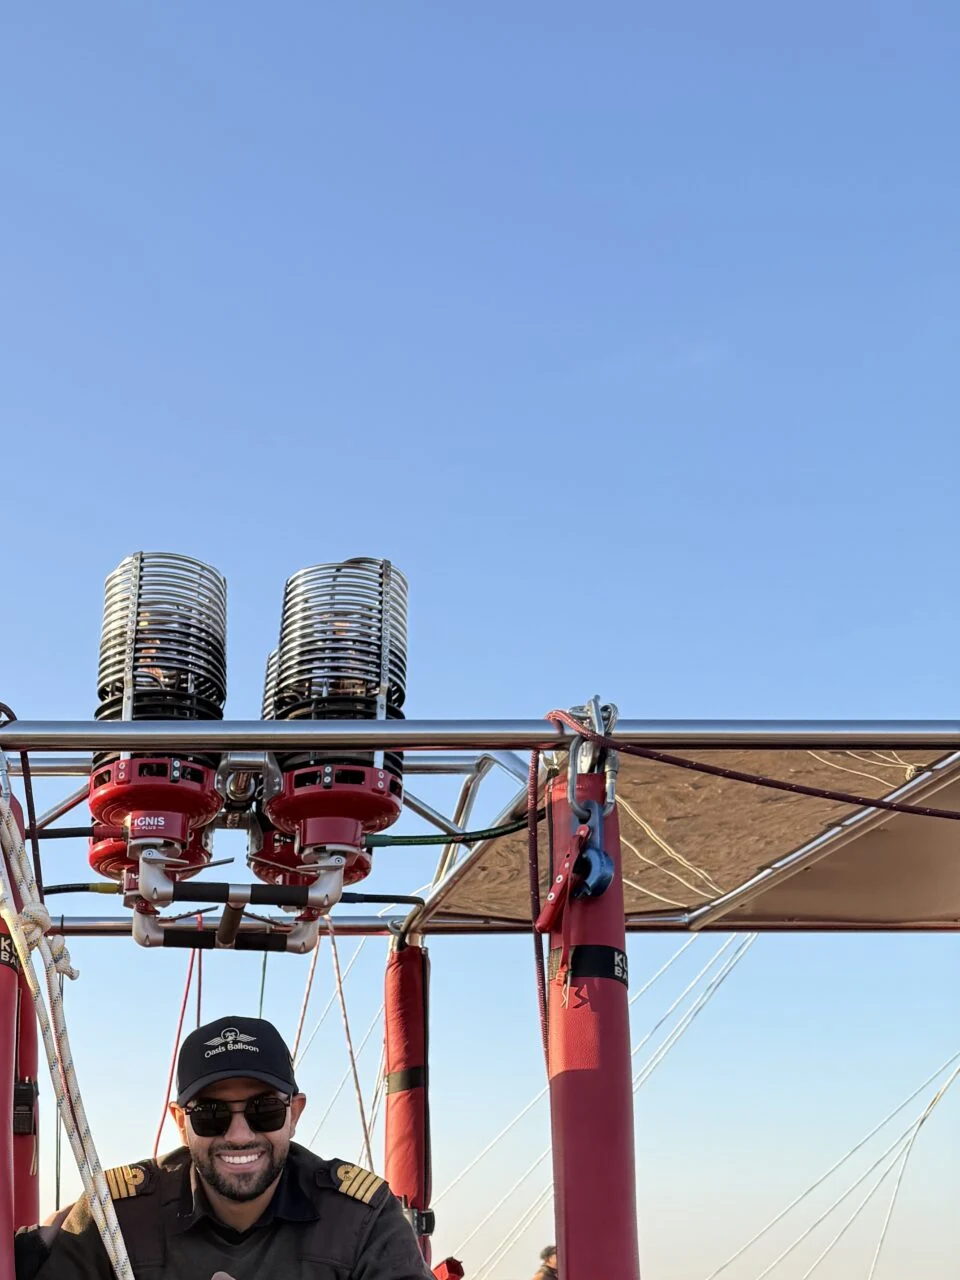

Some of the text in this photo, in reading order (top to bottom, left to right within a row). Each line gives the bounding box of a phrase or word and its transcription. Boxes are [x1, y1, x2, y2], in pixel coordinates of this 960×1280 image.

[134, 816, 165, 827] IGNIS
[204, 1042, 260, 1058] Oasis Balloon
